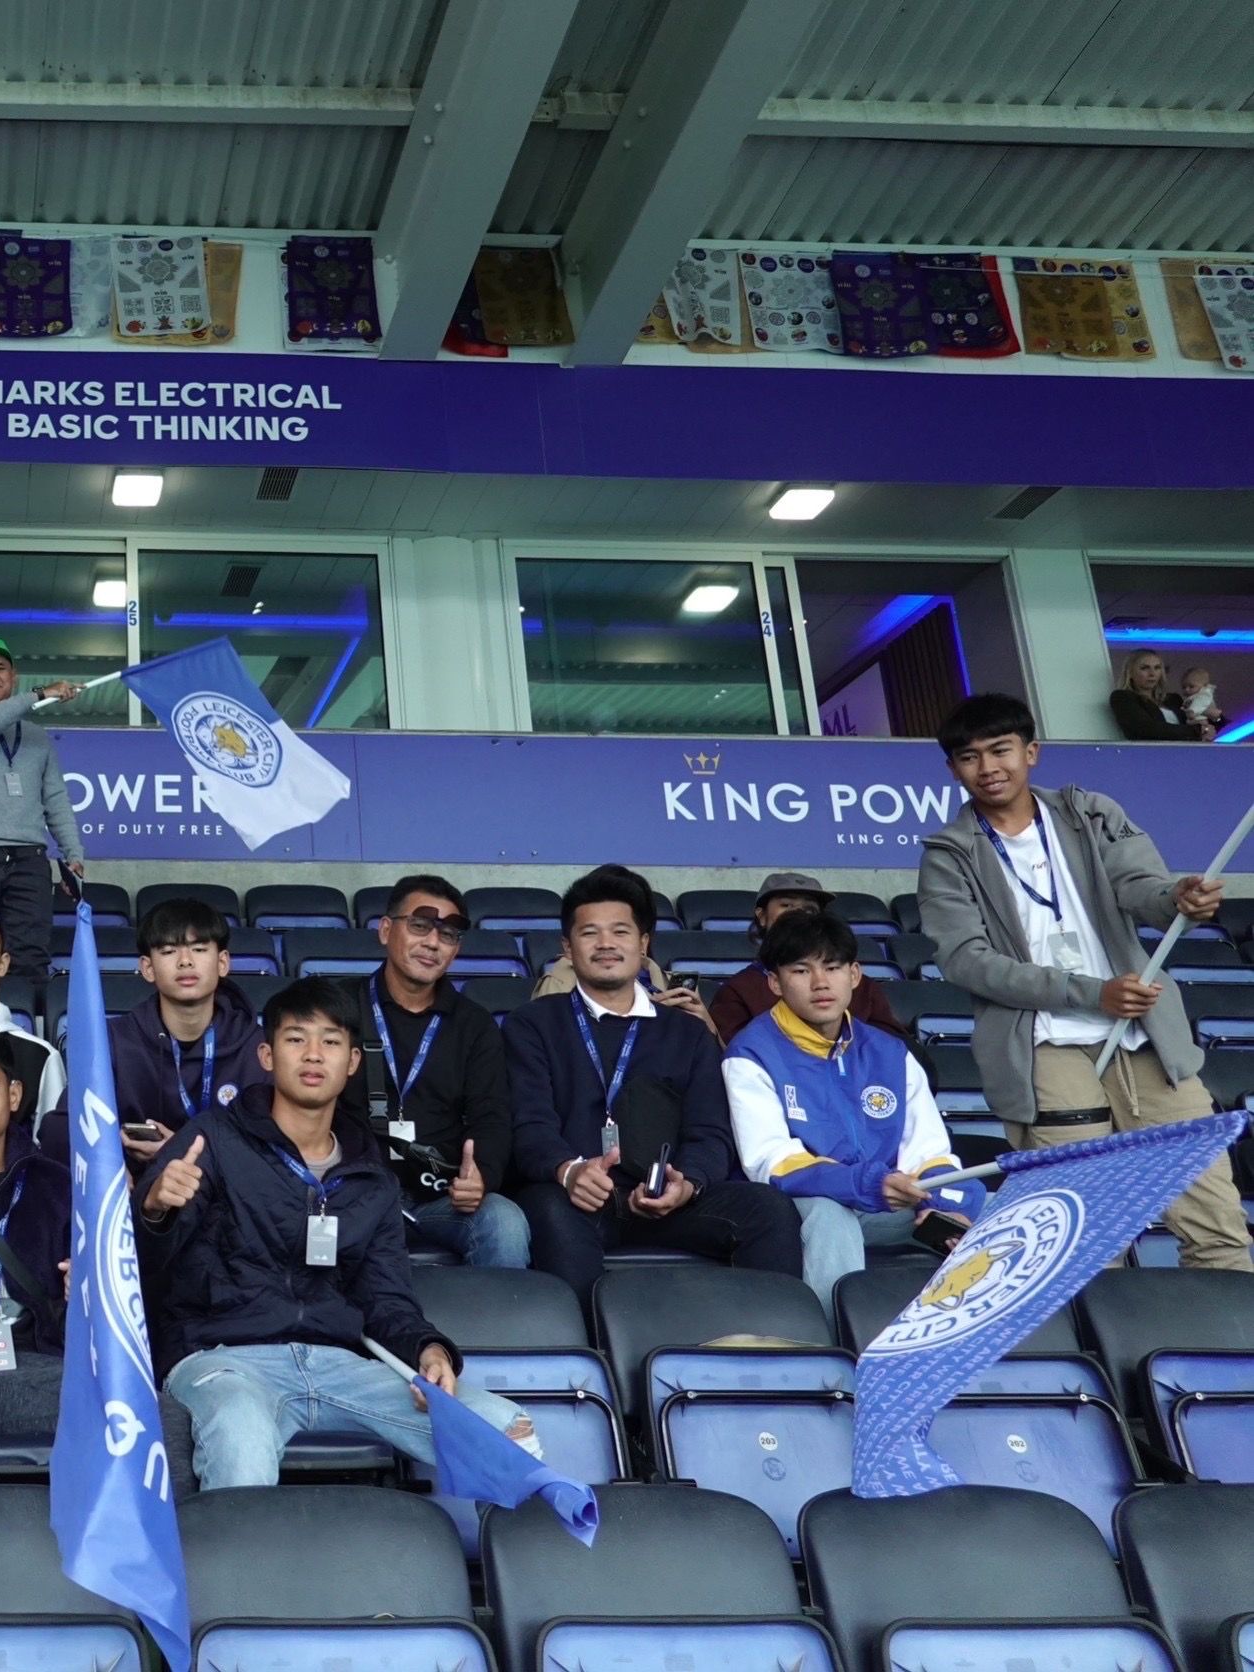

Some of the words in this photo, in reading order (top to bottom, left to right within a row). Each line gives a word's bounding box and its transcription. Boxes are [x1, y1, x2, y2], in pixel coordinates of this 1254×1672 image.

[114, 381, 343, 410] ELECTRICAL
[7, 413, 120, 440] BASIC
[128, 414, 310, 442] THINKING
[203, 702, 274, 753] LEICESTER
[62, 772, 219, 813] OWER
[663, 782, 810, 823] KING
[829, 783, 973, 824] POW
[82, 823, 105, 834] OF
[119, 824, 166, 835] DUTY
[180, 825, 223, 836] FREE
[837, 833, 884, 845] KING
[897, 834, 921, 845] OF
[760, 1436, 776, 1446] 203
